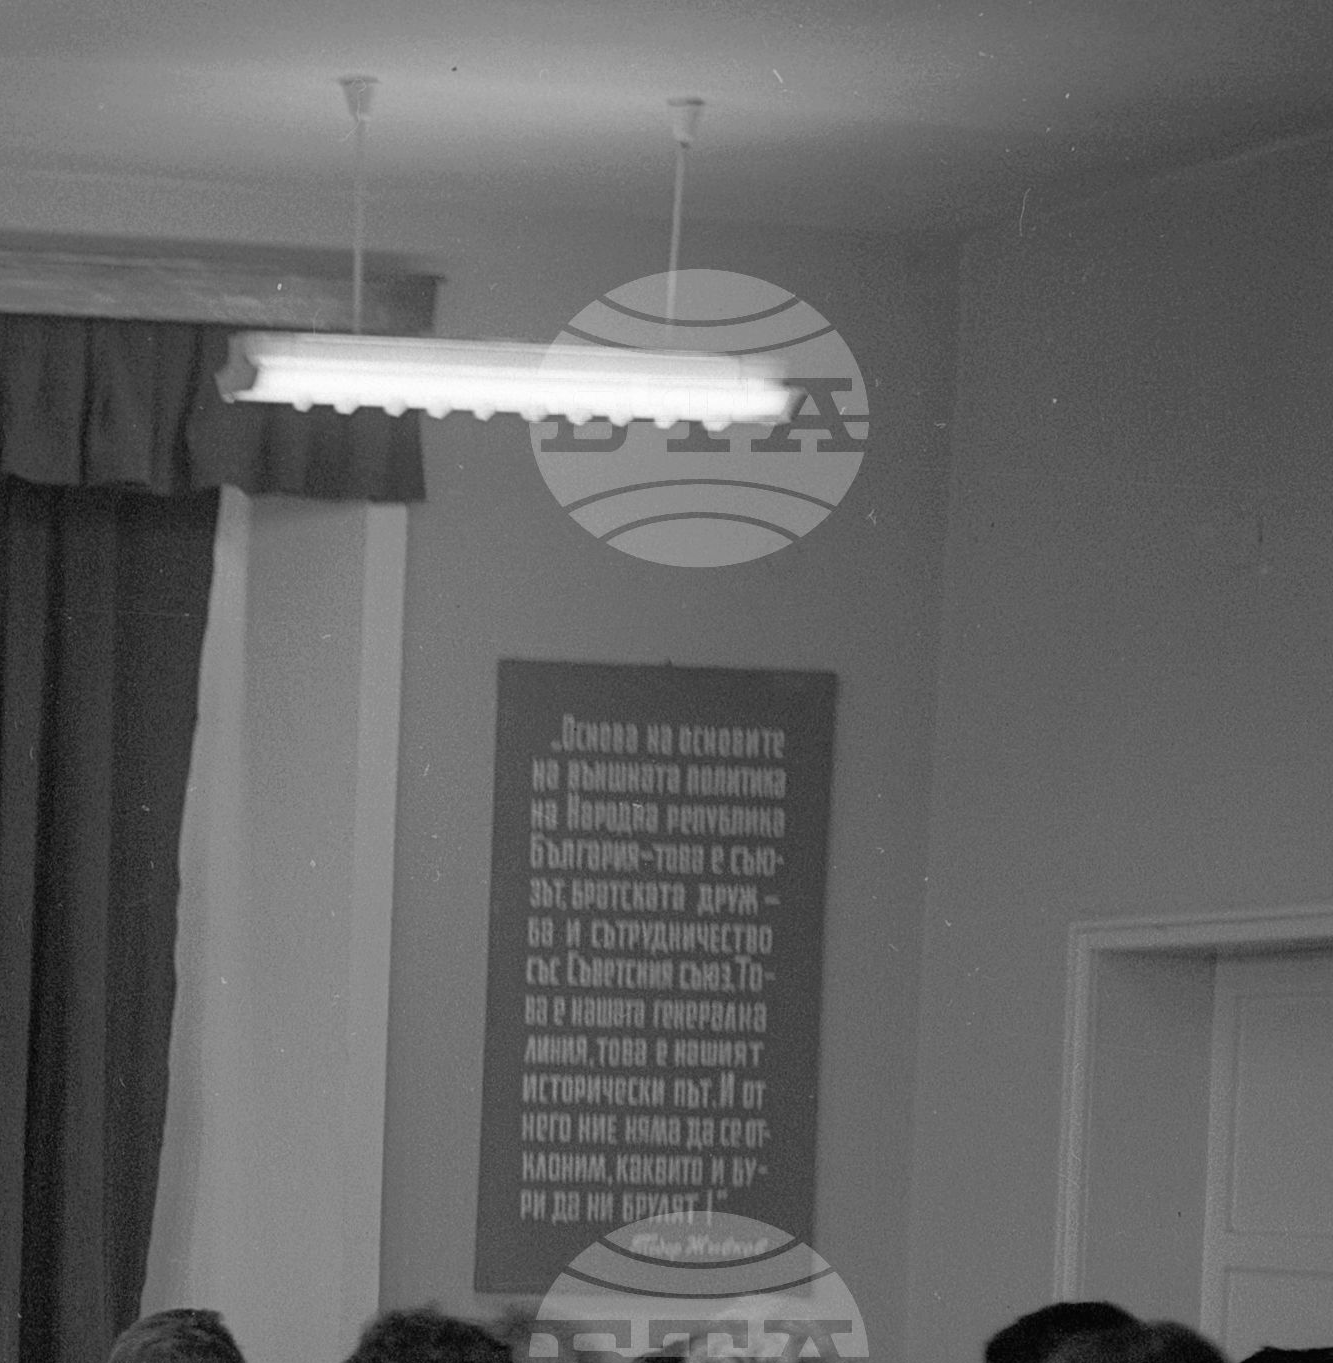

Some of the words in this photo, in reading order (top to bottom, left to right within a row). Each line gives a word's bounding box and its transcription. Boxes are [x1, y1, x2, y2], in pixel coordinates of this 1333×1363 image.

[647, 723, 672, 756] на
[679, 724, 785, 759] основите
[532, 758, 559, 792] на
[567, 760, 680, 795] външната
[686, 764, 786, 798] политика
[530, 798, 558, 831] на
[567, 792, 659, 835] Народна
[666, 804, 785, 838] република
[572, 878, 685, 912] братската
[527, 916, 554, 948] ба
[566, 917, 581, 948] и
[590, 919, 773, 955] сътрудничество
[526, 955, 560, 986] със
[566, 950, 673, 988] Съветския
[524, 994, 548, 1027] ва
[553, 996, 565, 1027] е
[571, 996, 646, 1029] нашата
[652, 998, 767, 1033] генерална
[596, 1036, 647, 1068] това
[656, 1038, 668, 1068] е
[674, 1038, 765, 1069] нашият
[522, 1073, 665, 1108] исторически
[742, 1080, 767, 1110] от
[625, 1115, 680, 1146] няма
[686, 1116, 714, 1151] да
[720, 1117, 742, 1148] се
[711, 1156, 724, 1185] и
[552, 1190, 580, 1226] да
[587, 1190, 614, 1222] ни
